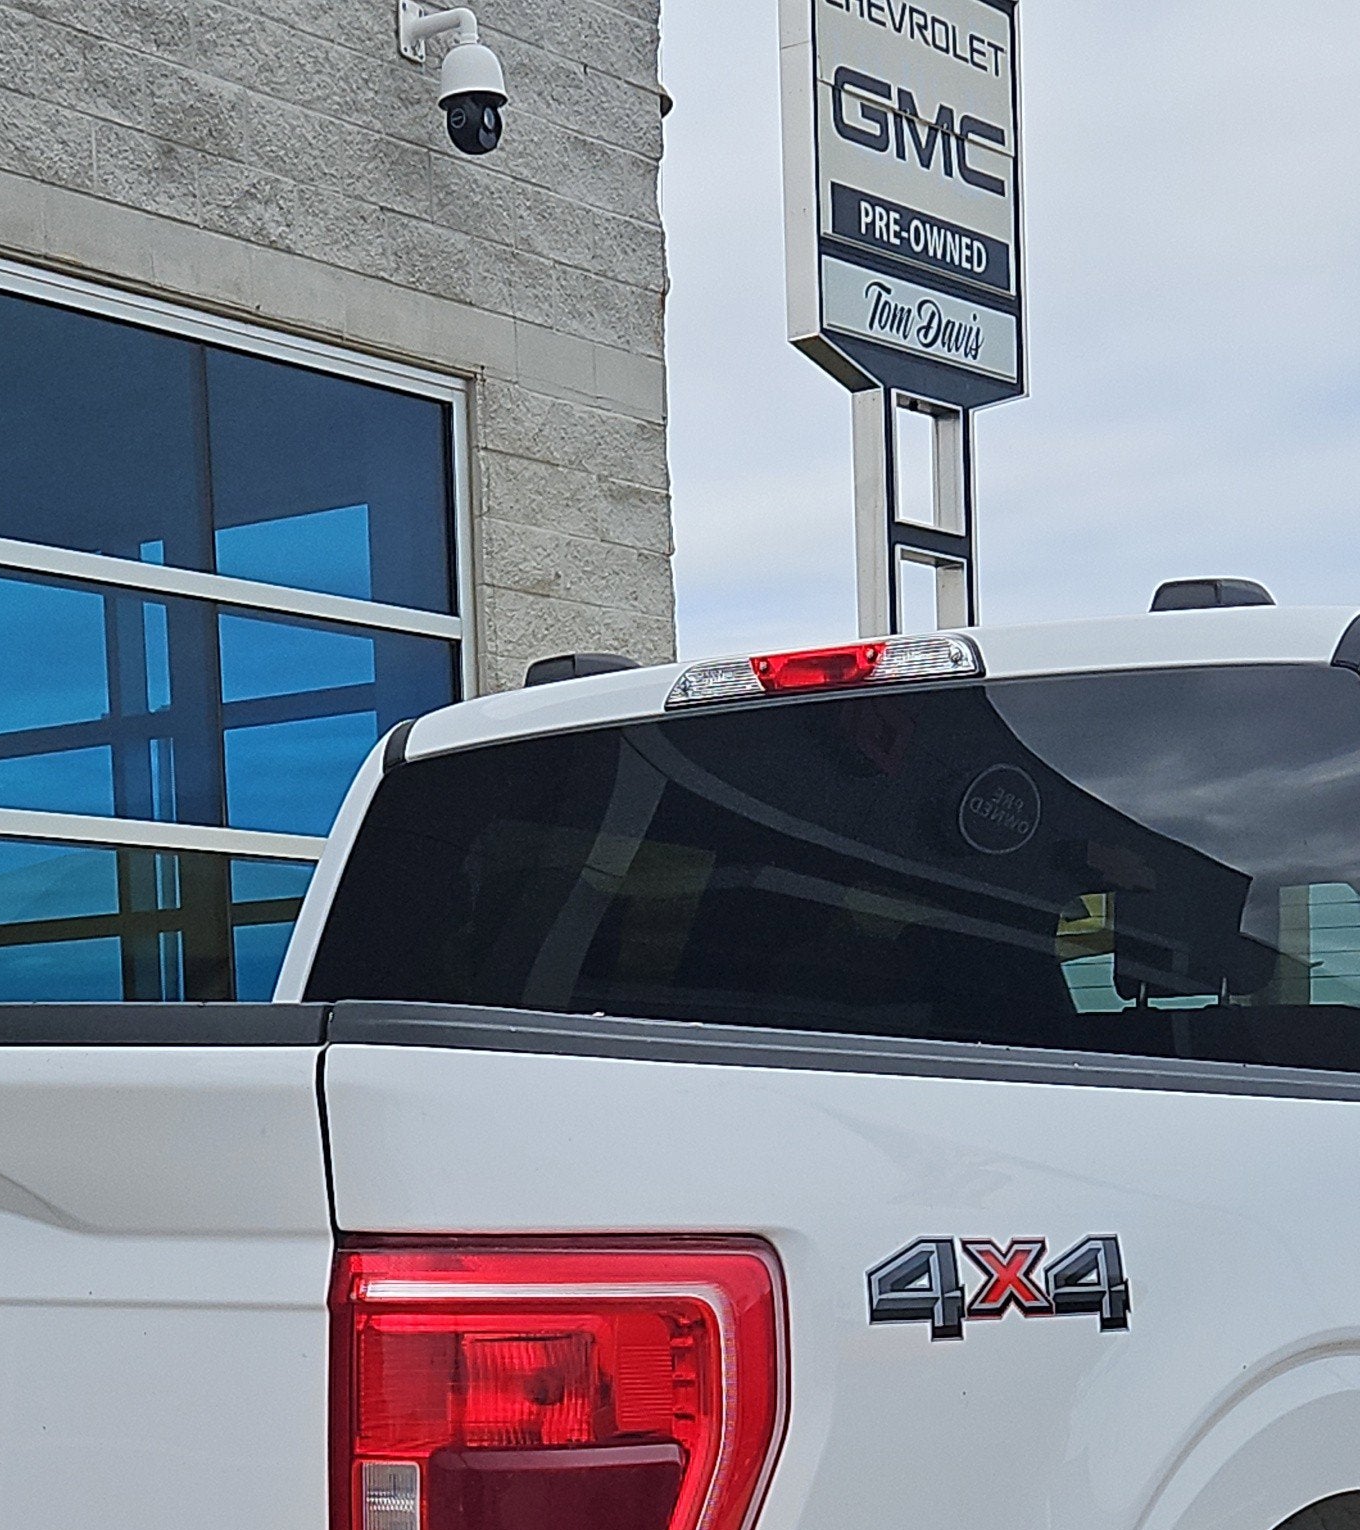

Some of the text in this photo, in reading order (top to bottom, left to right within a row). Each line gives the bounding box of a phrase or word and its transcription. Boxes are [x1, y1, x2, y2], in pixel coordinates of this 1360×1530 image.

[825, 0, 1006, 77] EVROLET
[833, 65, 1006, 198] GMC
[859, 200, 988, 274] PRE-OWNED
[865, 280, 984, 361] Tom Davis
